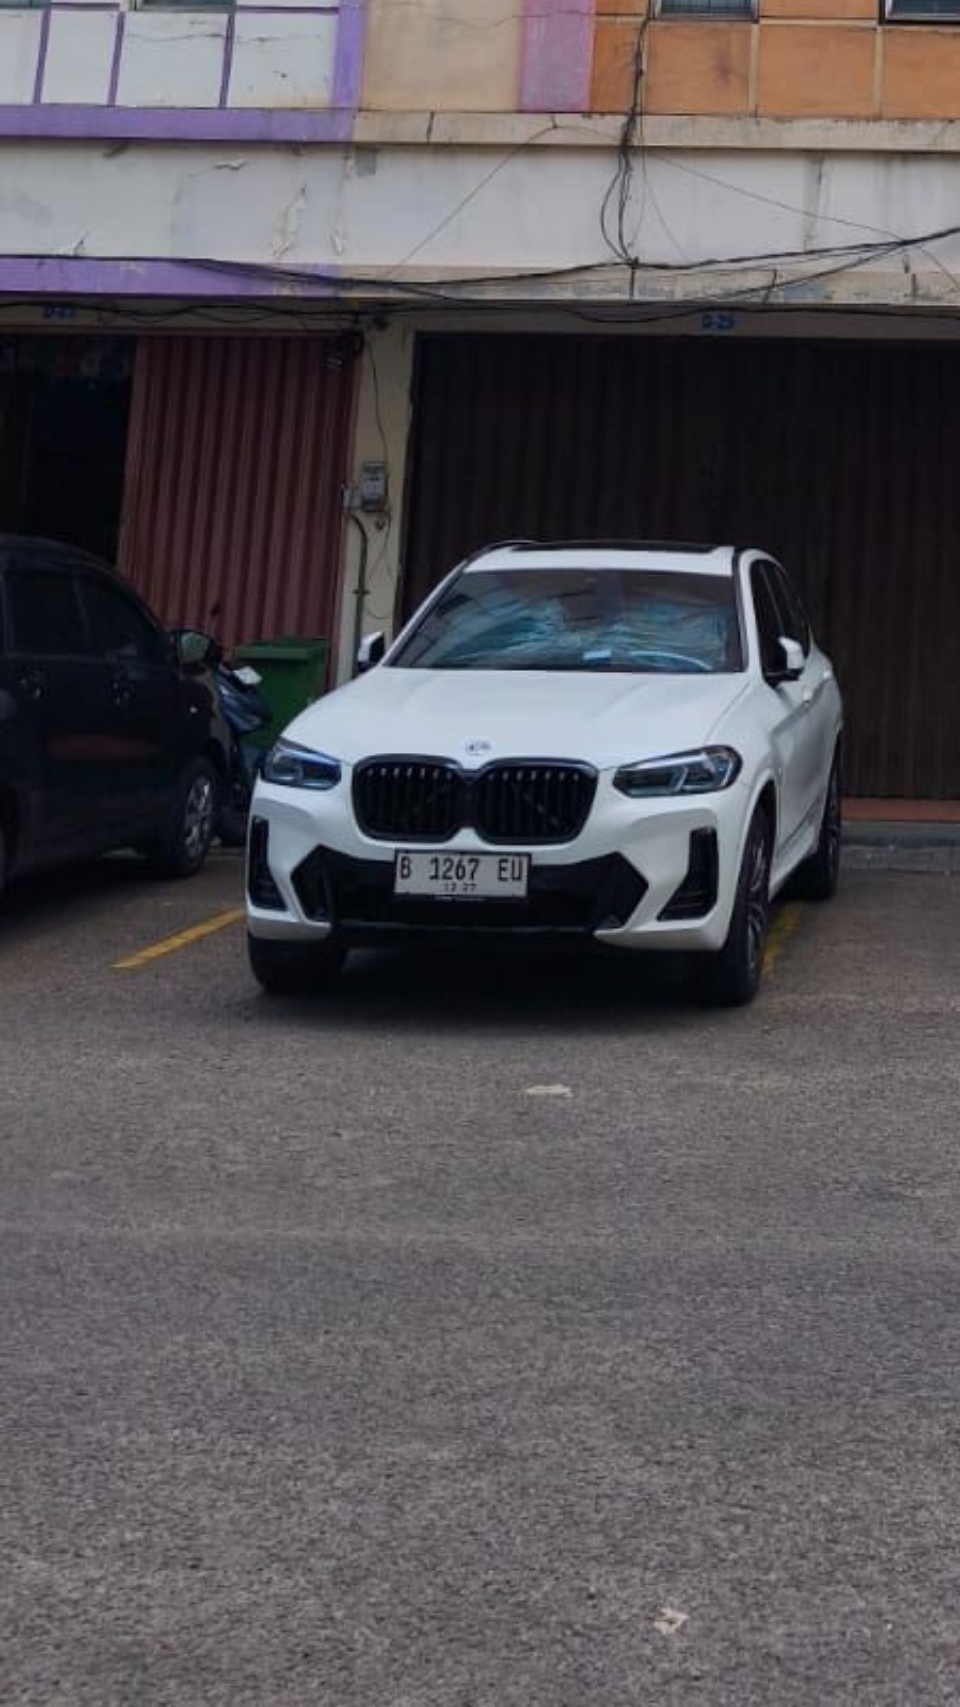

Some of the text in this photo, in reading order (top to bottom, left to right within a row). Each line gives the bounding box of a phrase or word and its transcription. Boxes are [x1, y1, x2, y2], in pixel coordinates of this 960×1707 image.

[400, 855, 523, 882] B 1267 EU
